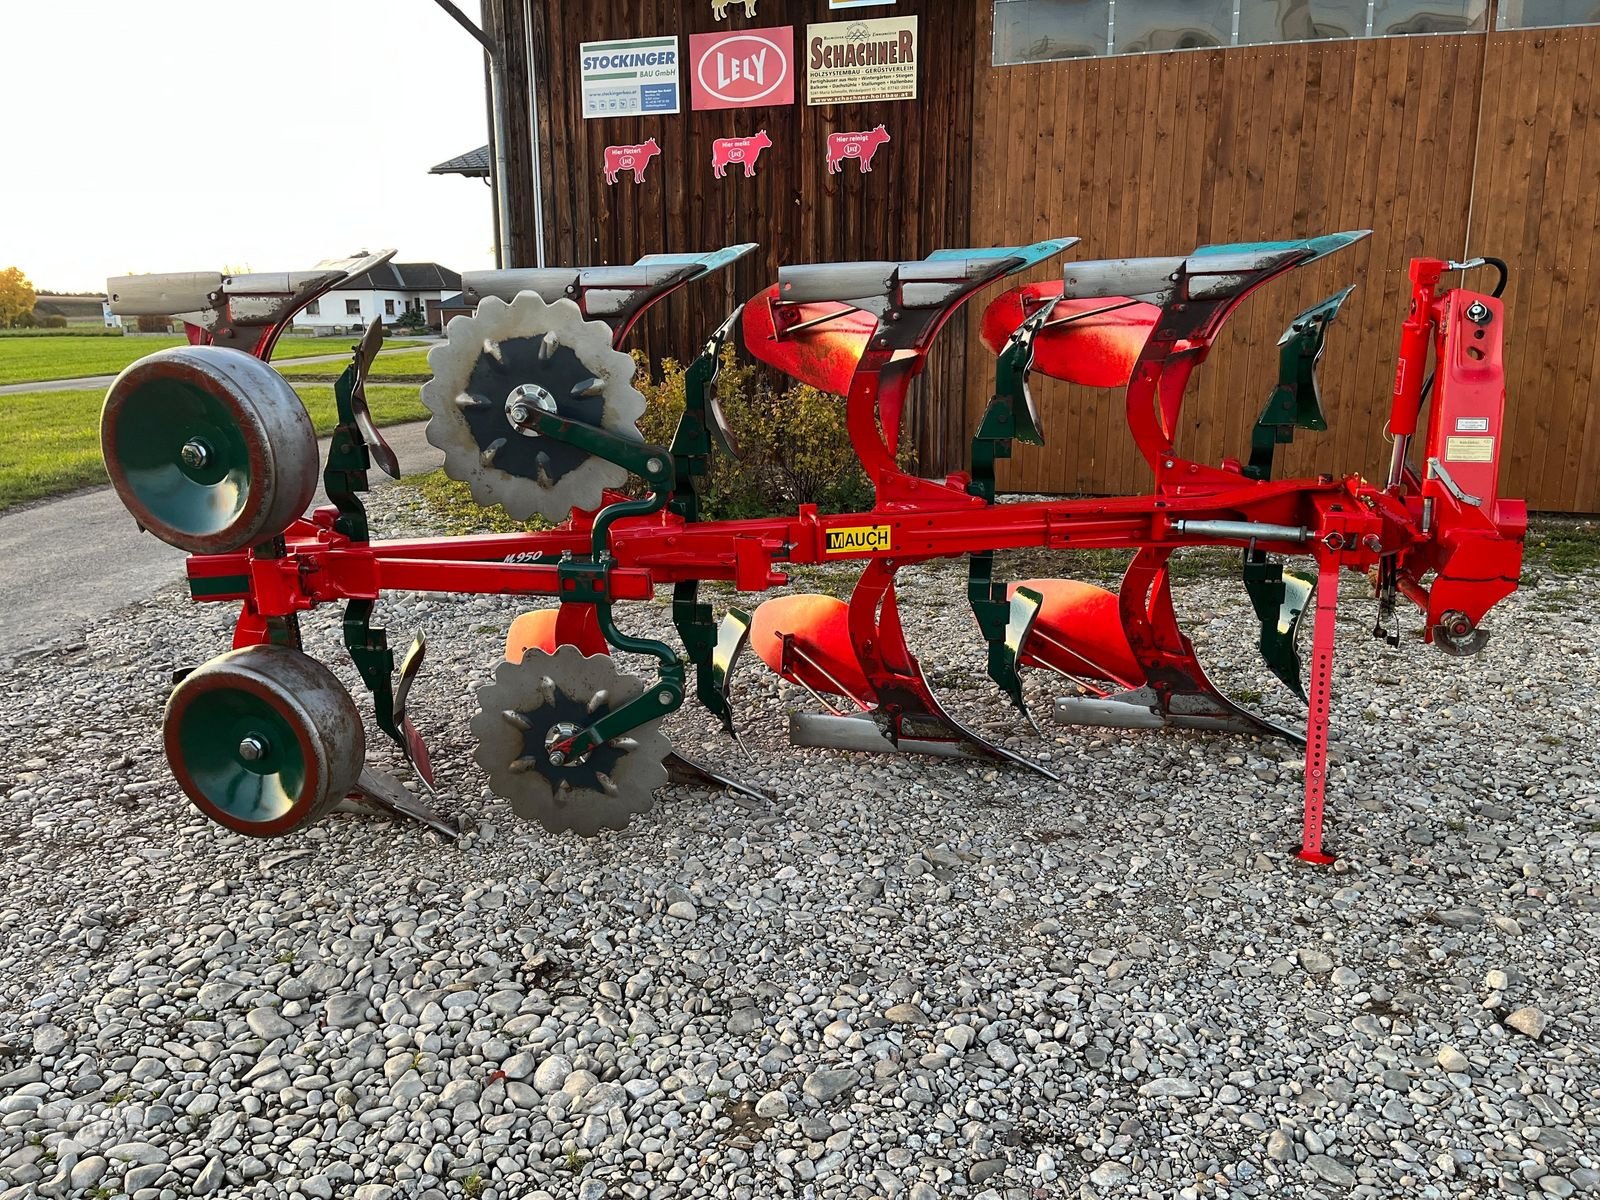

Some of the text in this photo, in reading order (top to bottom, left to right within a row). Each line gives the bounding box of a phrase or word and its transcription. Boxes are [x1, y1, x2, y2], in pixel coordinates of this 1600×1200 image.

[810, 30, 914, 70] SCHACHNER
[583, 51, 676, 70] STOCKINGER
[640, 69, 676, 78] BAU GmbH
[717, 47, 767, 90] LELY
[810, 65, 914, 78] HOLZSYSTEMBAU GERÜSTVERLEIH
[814, 92, 908, 103] www.schachner-holzbau.at
[830, 531, 888, 549] MAUCH
[516, 550, 543, 563] 950
